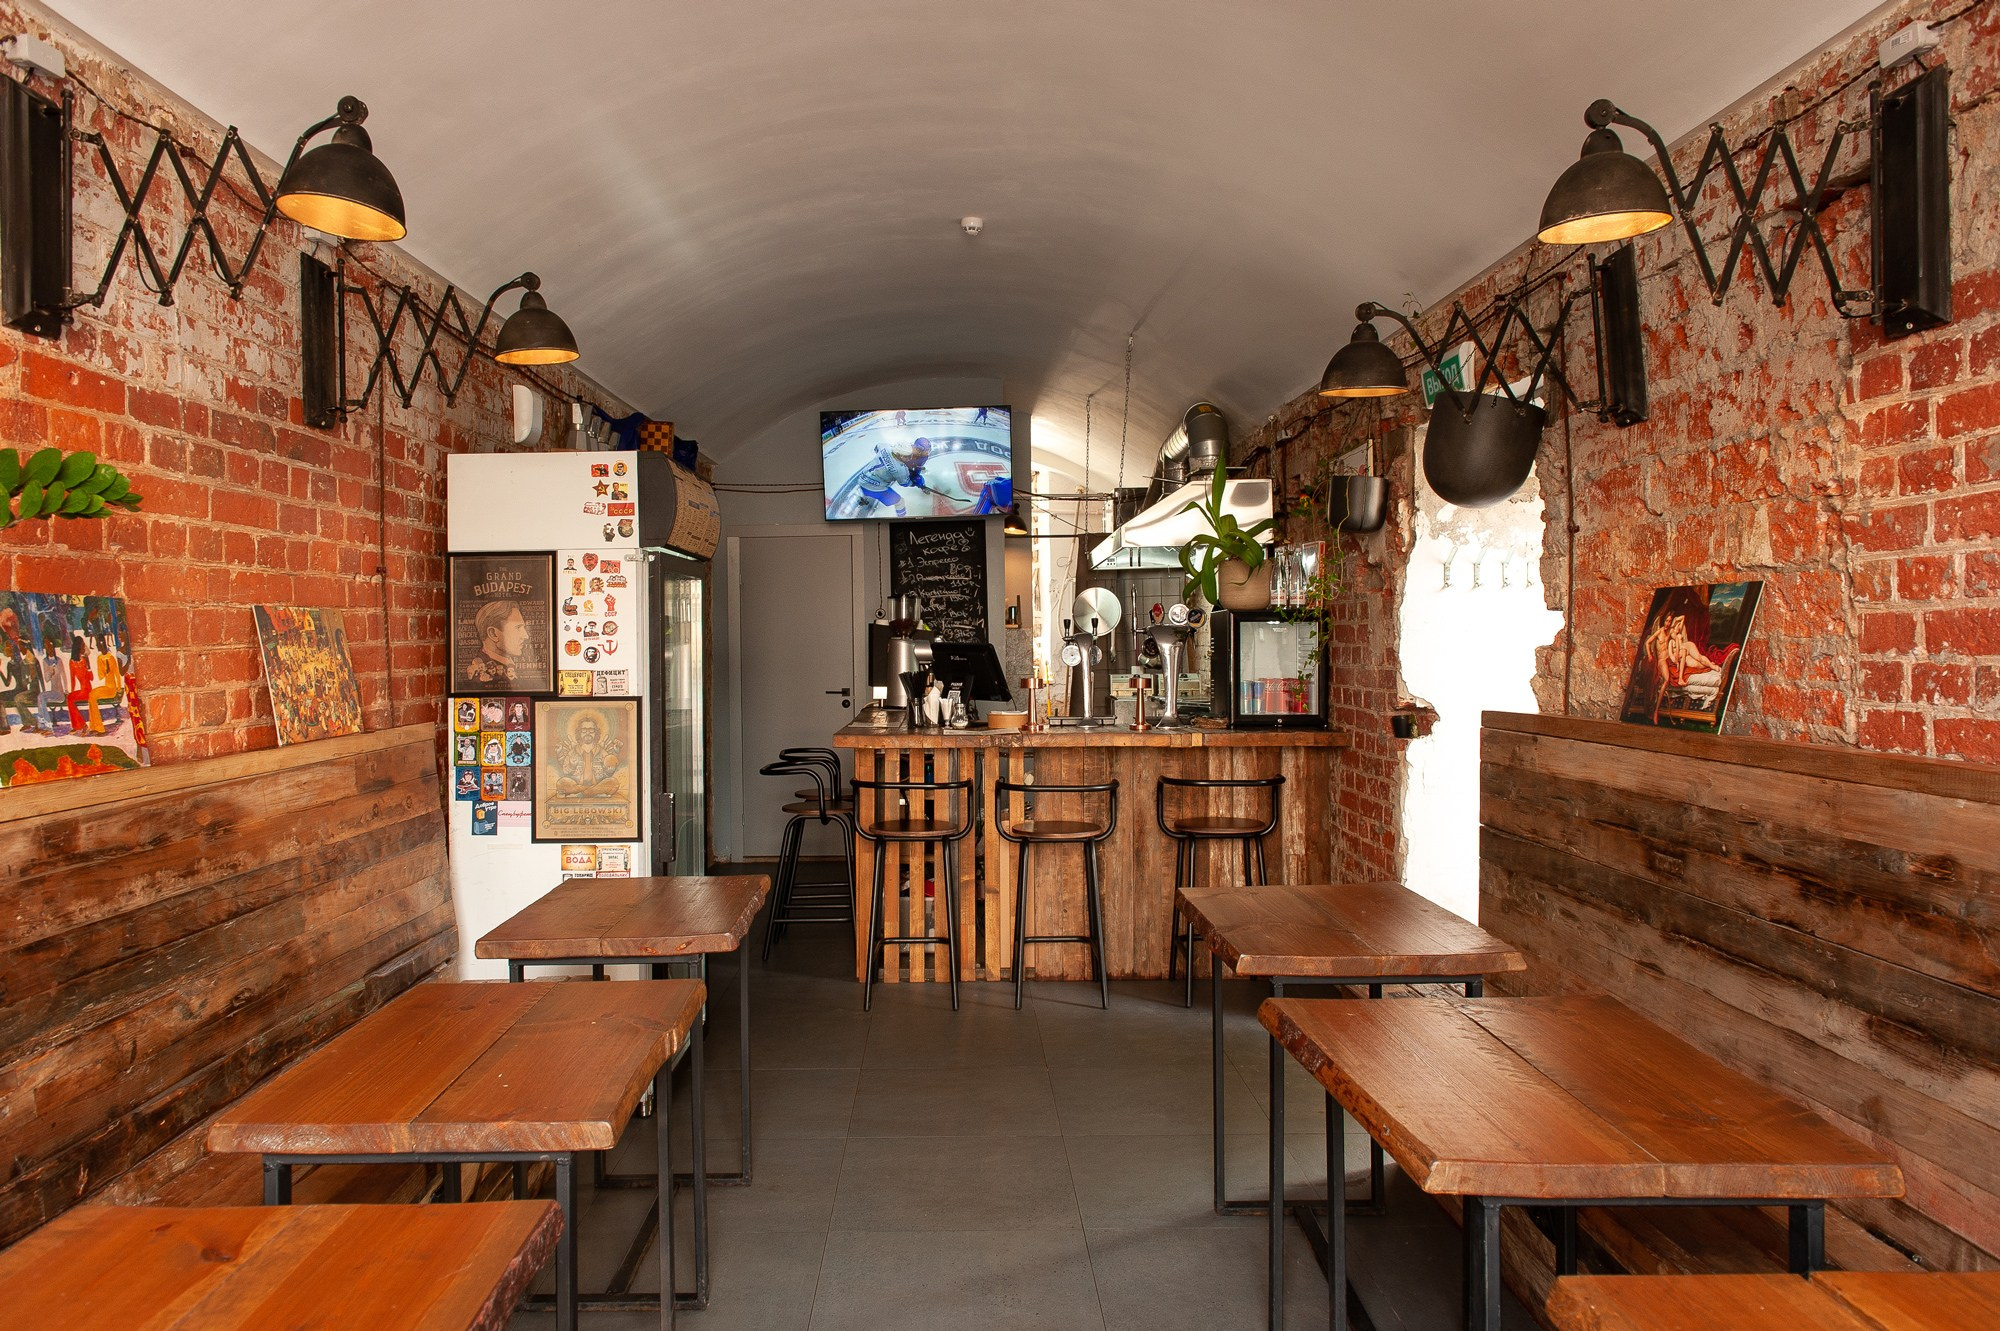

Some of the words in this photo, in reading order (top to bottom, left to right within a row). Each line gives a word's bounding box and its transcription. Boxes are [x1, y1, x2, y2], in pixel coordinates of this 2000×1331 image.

[1426, 364, 1460, 396] ВЫОД
[910, 530, 965, 546] Легенда
[922, 544, 959, 556] кофе
[486, 572, 522, 581] GRAND
[473, 581, 533, 597] BUDAPEST
[565, 856, 593, 864] ВОДА
